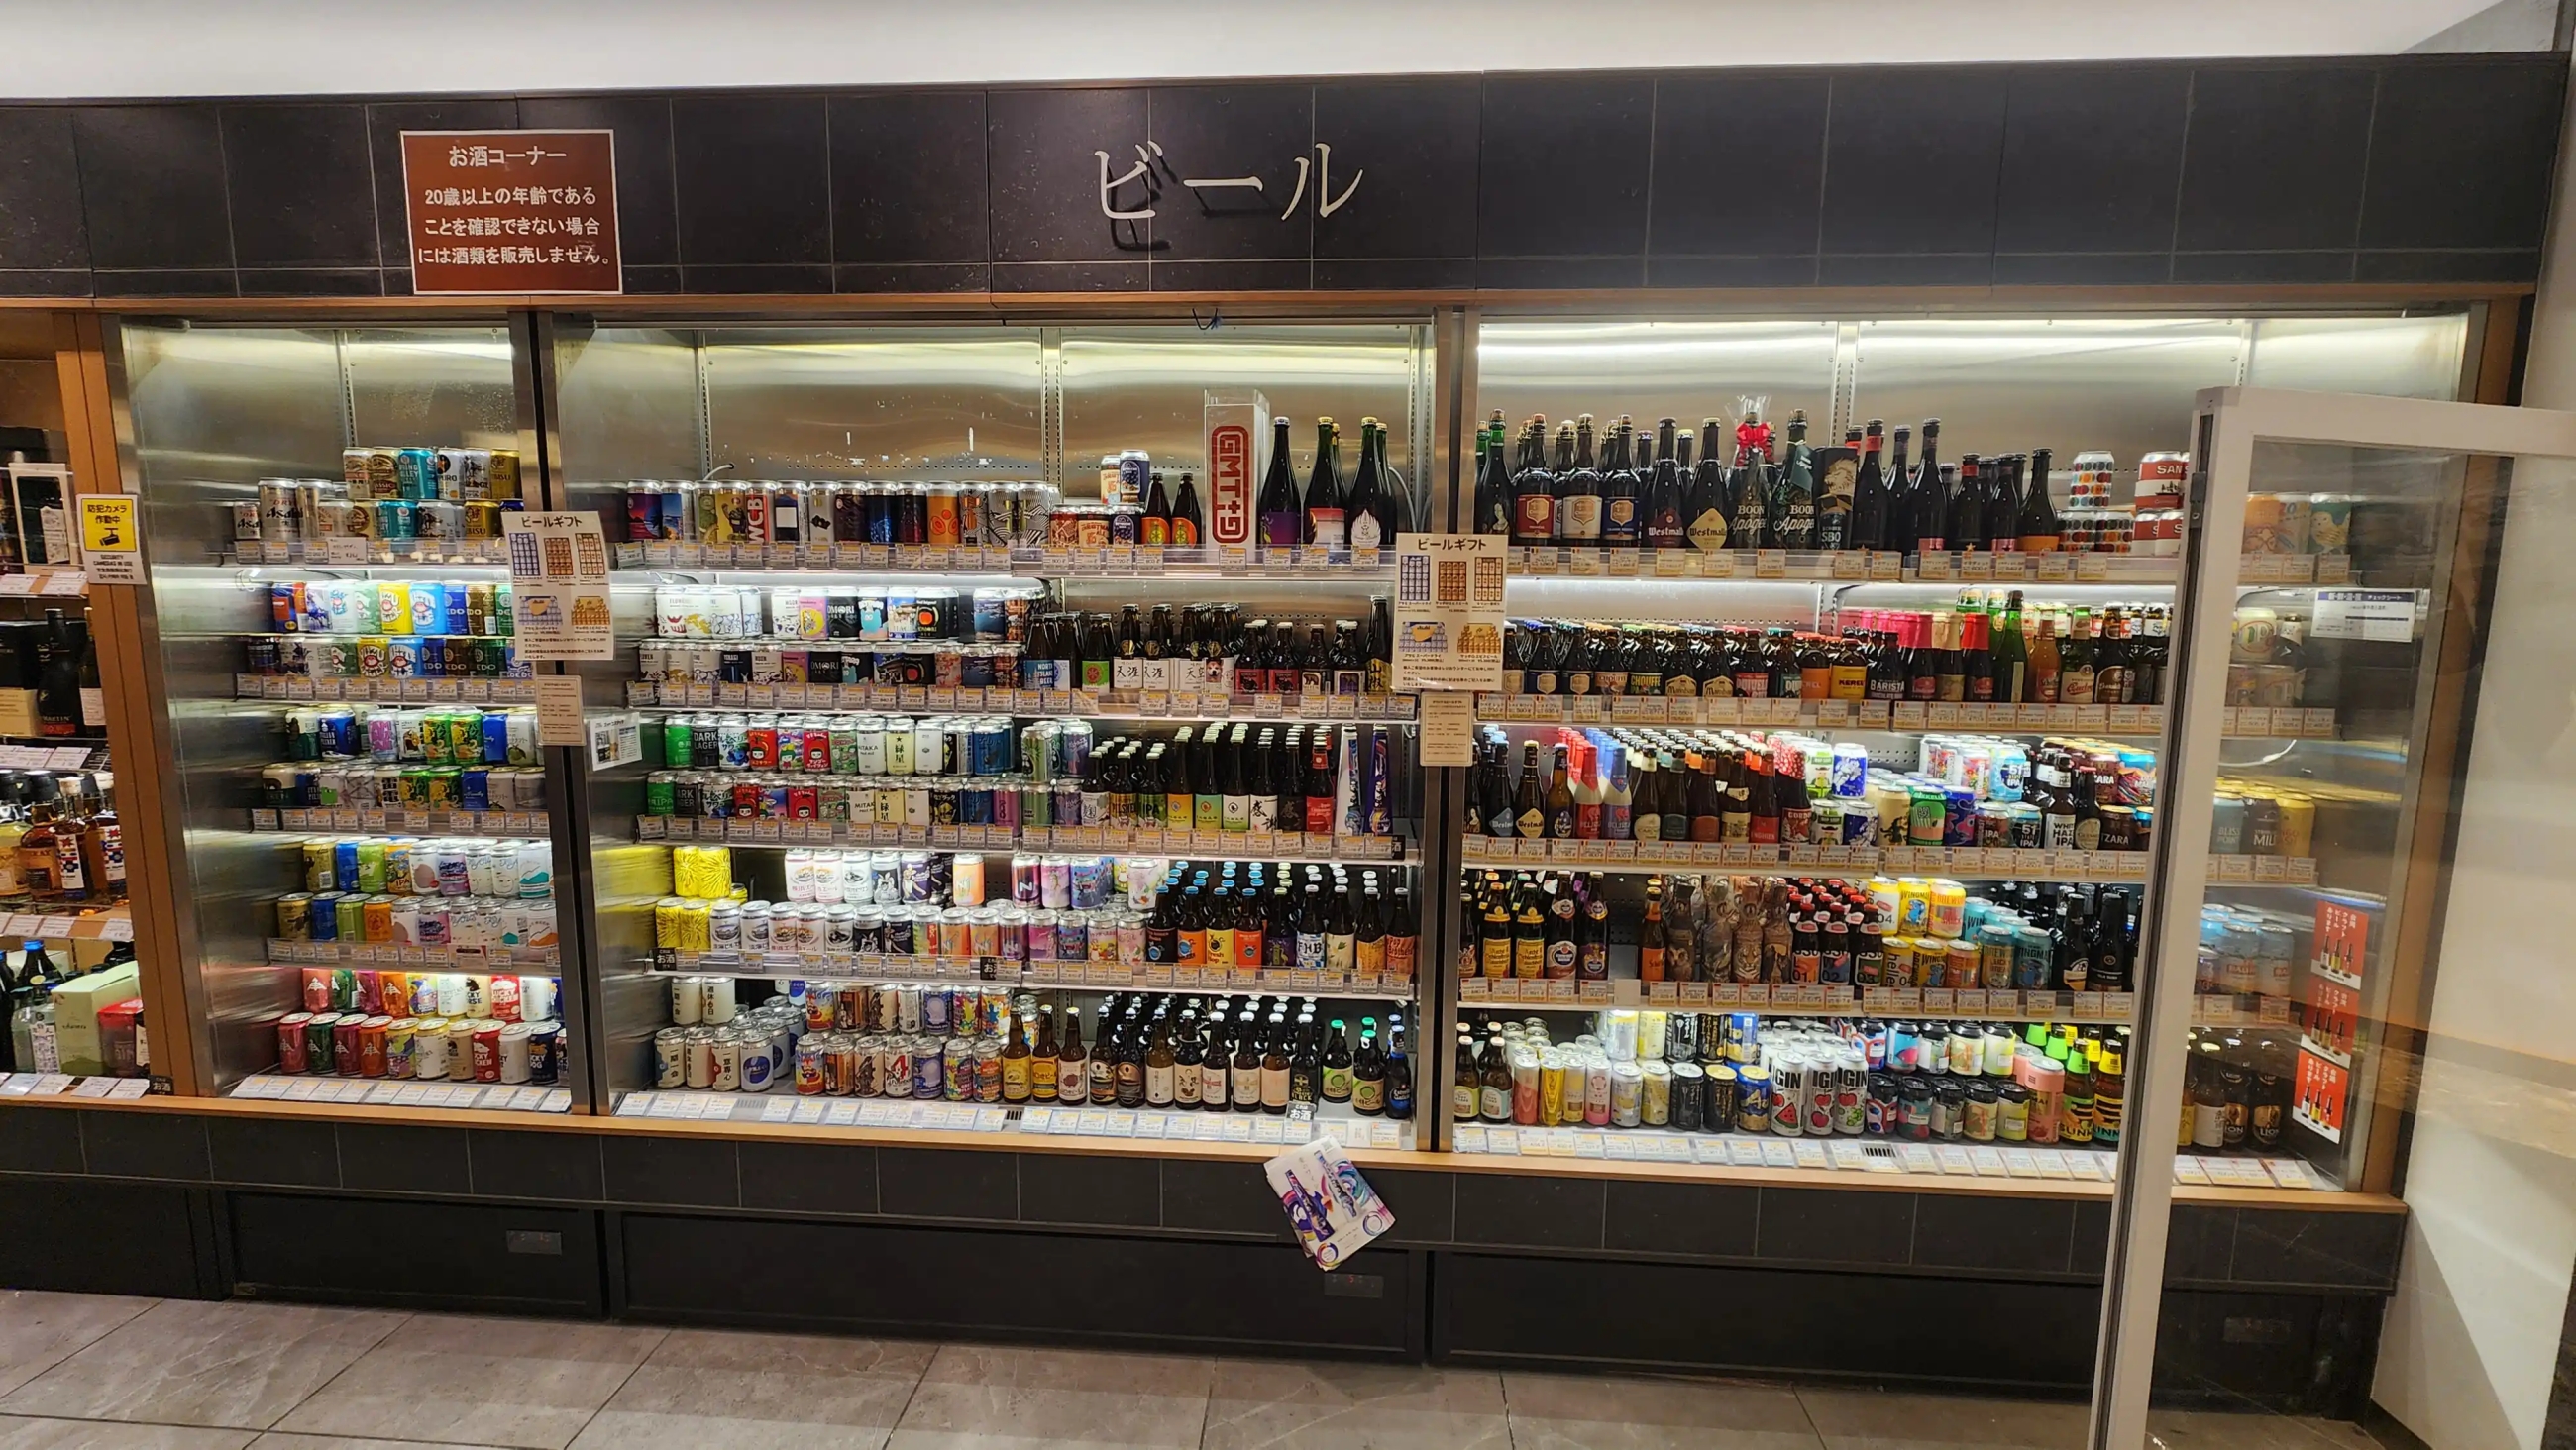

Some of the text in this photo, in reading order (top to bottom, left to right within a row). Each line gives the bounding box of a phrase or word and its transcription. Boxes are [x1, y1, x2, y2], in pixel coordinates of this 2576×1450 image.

[449, 146, 567, 167] お酒コーナー
[1094, 140, 1363, 221] ビール
[425, 186, 596, 206] 20歳以上の年齢である
[425, 217, 600, 236] ことを確認できない場合
[418, 247, 609, 264] には酒類を販売しません。
[87, 504, 127, 513] 防犯カメラ
[1737, 505, 1765, 515] BOON
[1789, 505, 1815, 515] BOON
[95, 515, 121, 524] 作動中
[521, 516, 582, 528] ビールギフト
[1418, 538, 1487, 551] ビールギフト
[1870, 680, 1905, 692] BARISTA
[694, 732, 717, 741] DARK
[695, 741, 718, 750] LAGER
[1297, 942, 1323, 954] FHB
[656, 955, 676, 964] お酒
[669, 1049, 680, 1079] 一期一会
[1289, 1109, 1312, 1121] お酒
